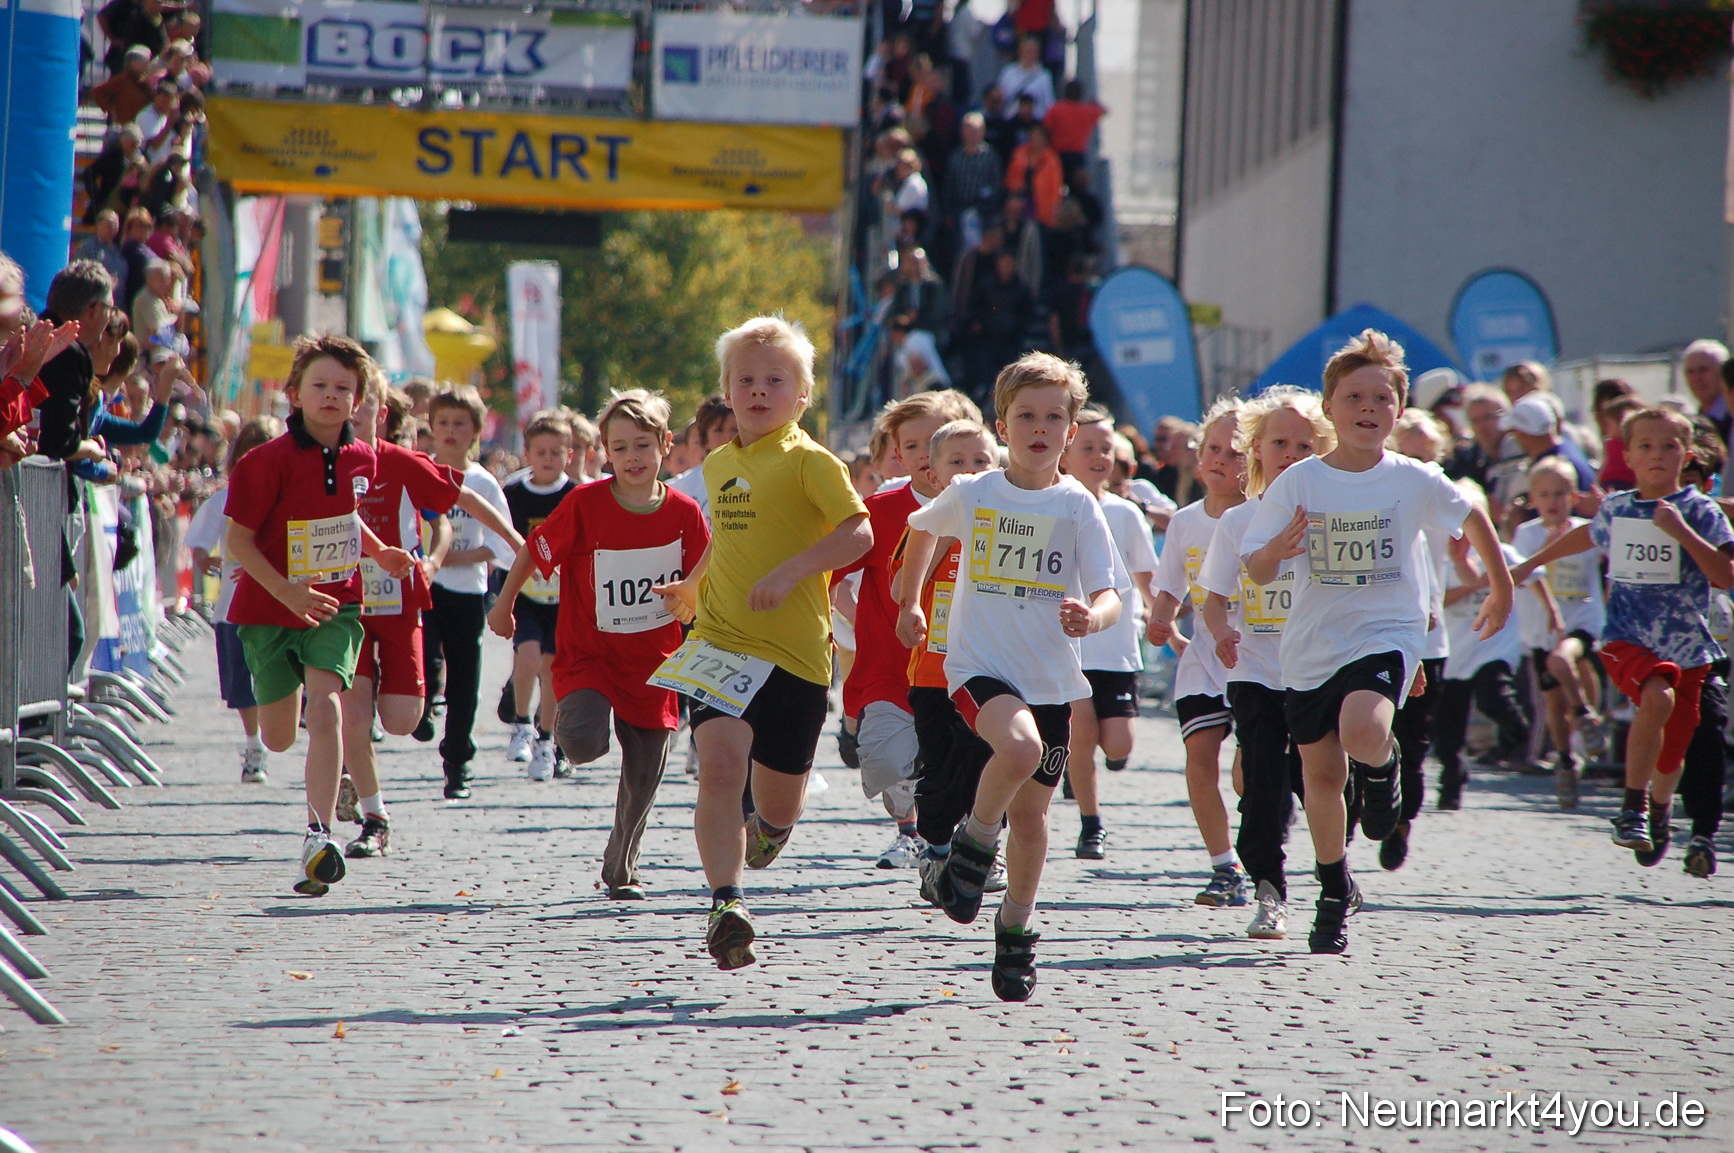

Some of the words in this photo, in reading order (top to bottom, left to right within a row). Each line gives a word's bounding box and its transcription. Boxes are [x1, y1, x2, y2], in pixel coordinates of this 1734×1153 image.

[307, 19, 547, 77] BOCK
[705, 44, 848, 75] PFLEIDERER
[416, 126, 632, 182] START
[717, 492, 751, 504] skinfit
[721, 509, 756, 519] Hilpoltstein
[311, 521, 354, 537] Jonathan
[721, 521, 748, 531] Triathlon
[998, 516, 1034, 537] Kilian
[1330, 515, 1392, 532] Alexander
[291, 544, 302, 554] K4
[313, 537, 358, 562] 7278
[974, 539, 986, 553] K4
[1311, 540, 1317, 550] K
[1333, 537, 1394, 562] 7015
[1626, 543, 1672, 562] 7305
[998, 543, 1063, 575] 7116
[1027, 586, 1065, 599] PFLEIDERER
[1246, 590, 1256, 599] K4
[1265, 590, 1292, 610] 70
[935, 607, 947, 619] K4
[673, 650, 686, 660] K4
[689, 653, 753, 694] 7273
[705, 692, 744, 713] PFLEIDERER
